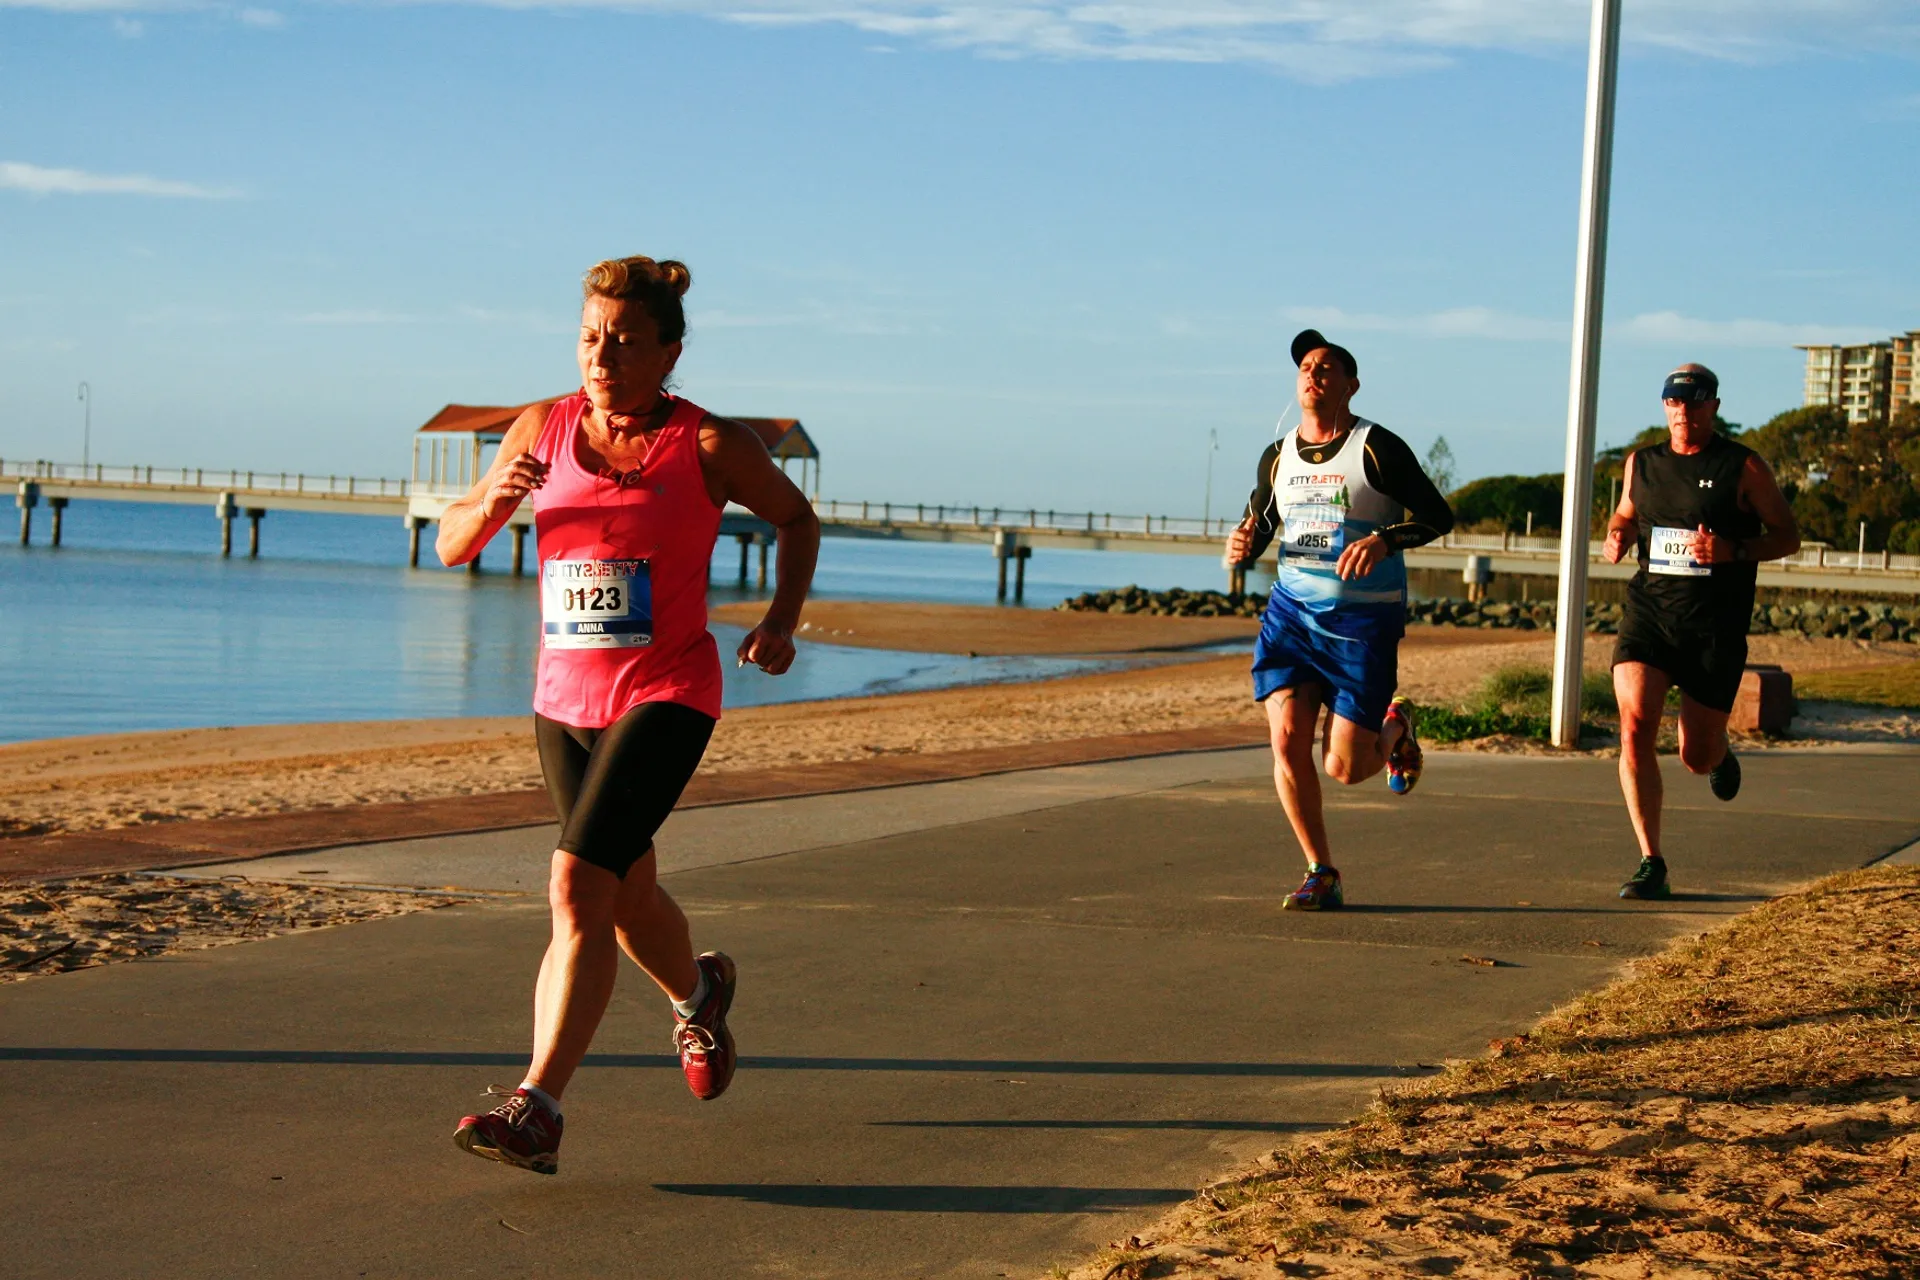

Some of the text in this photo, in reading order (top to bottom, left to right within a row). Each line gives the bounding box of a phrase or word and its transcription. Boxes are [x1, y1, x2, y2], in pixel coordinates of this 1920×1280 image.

[1297, 534, 1328, 548] 0256
[1664, 542, 1692, 556] 037
[564, 587, 622, 611] 0123
[577, 623, 605, 633] ANNA
